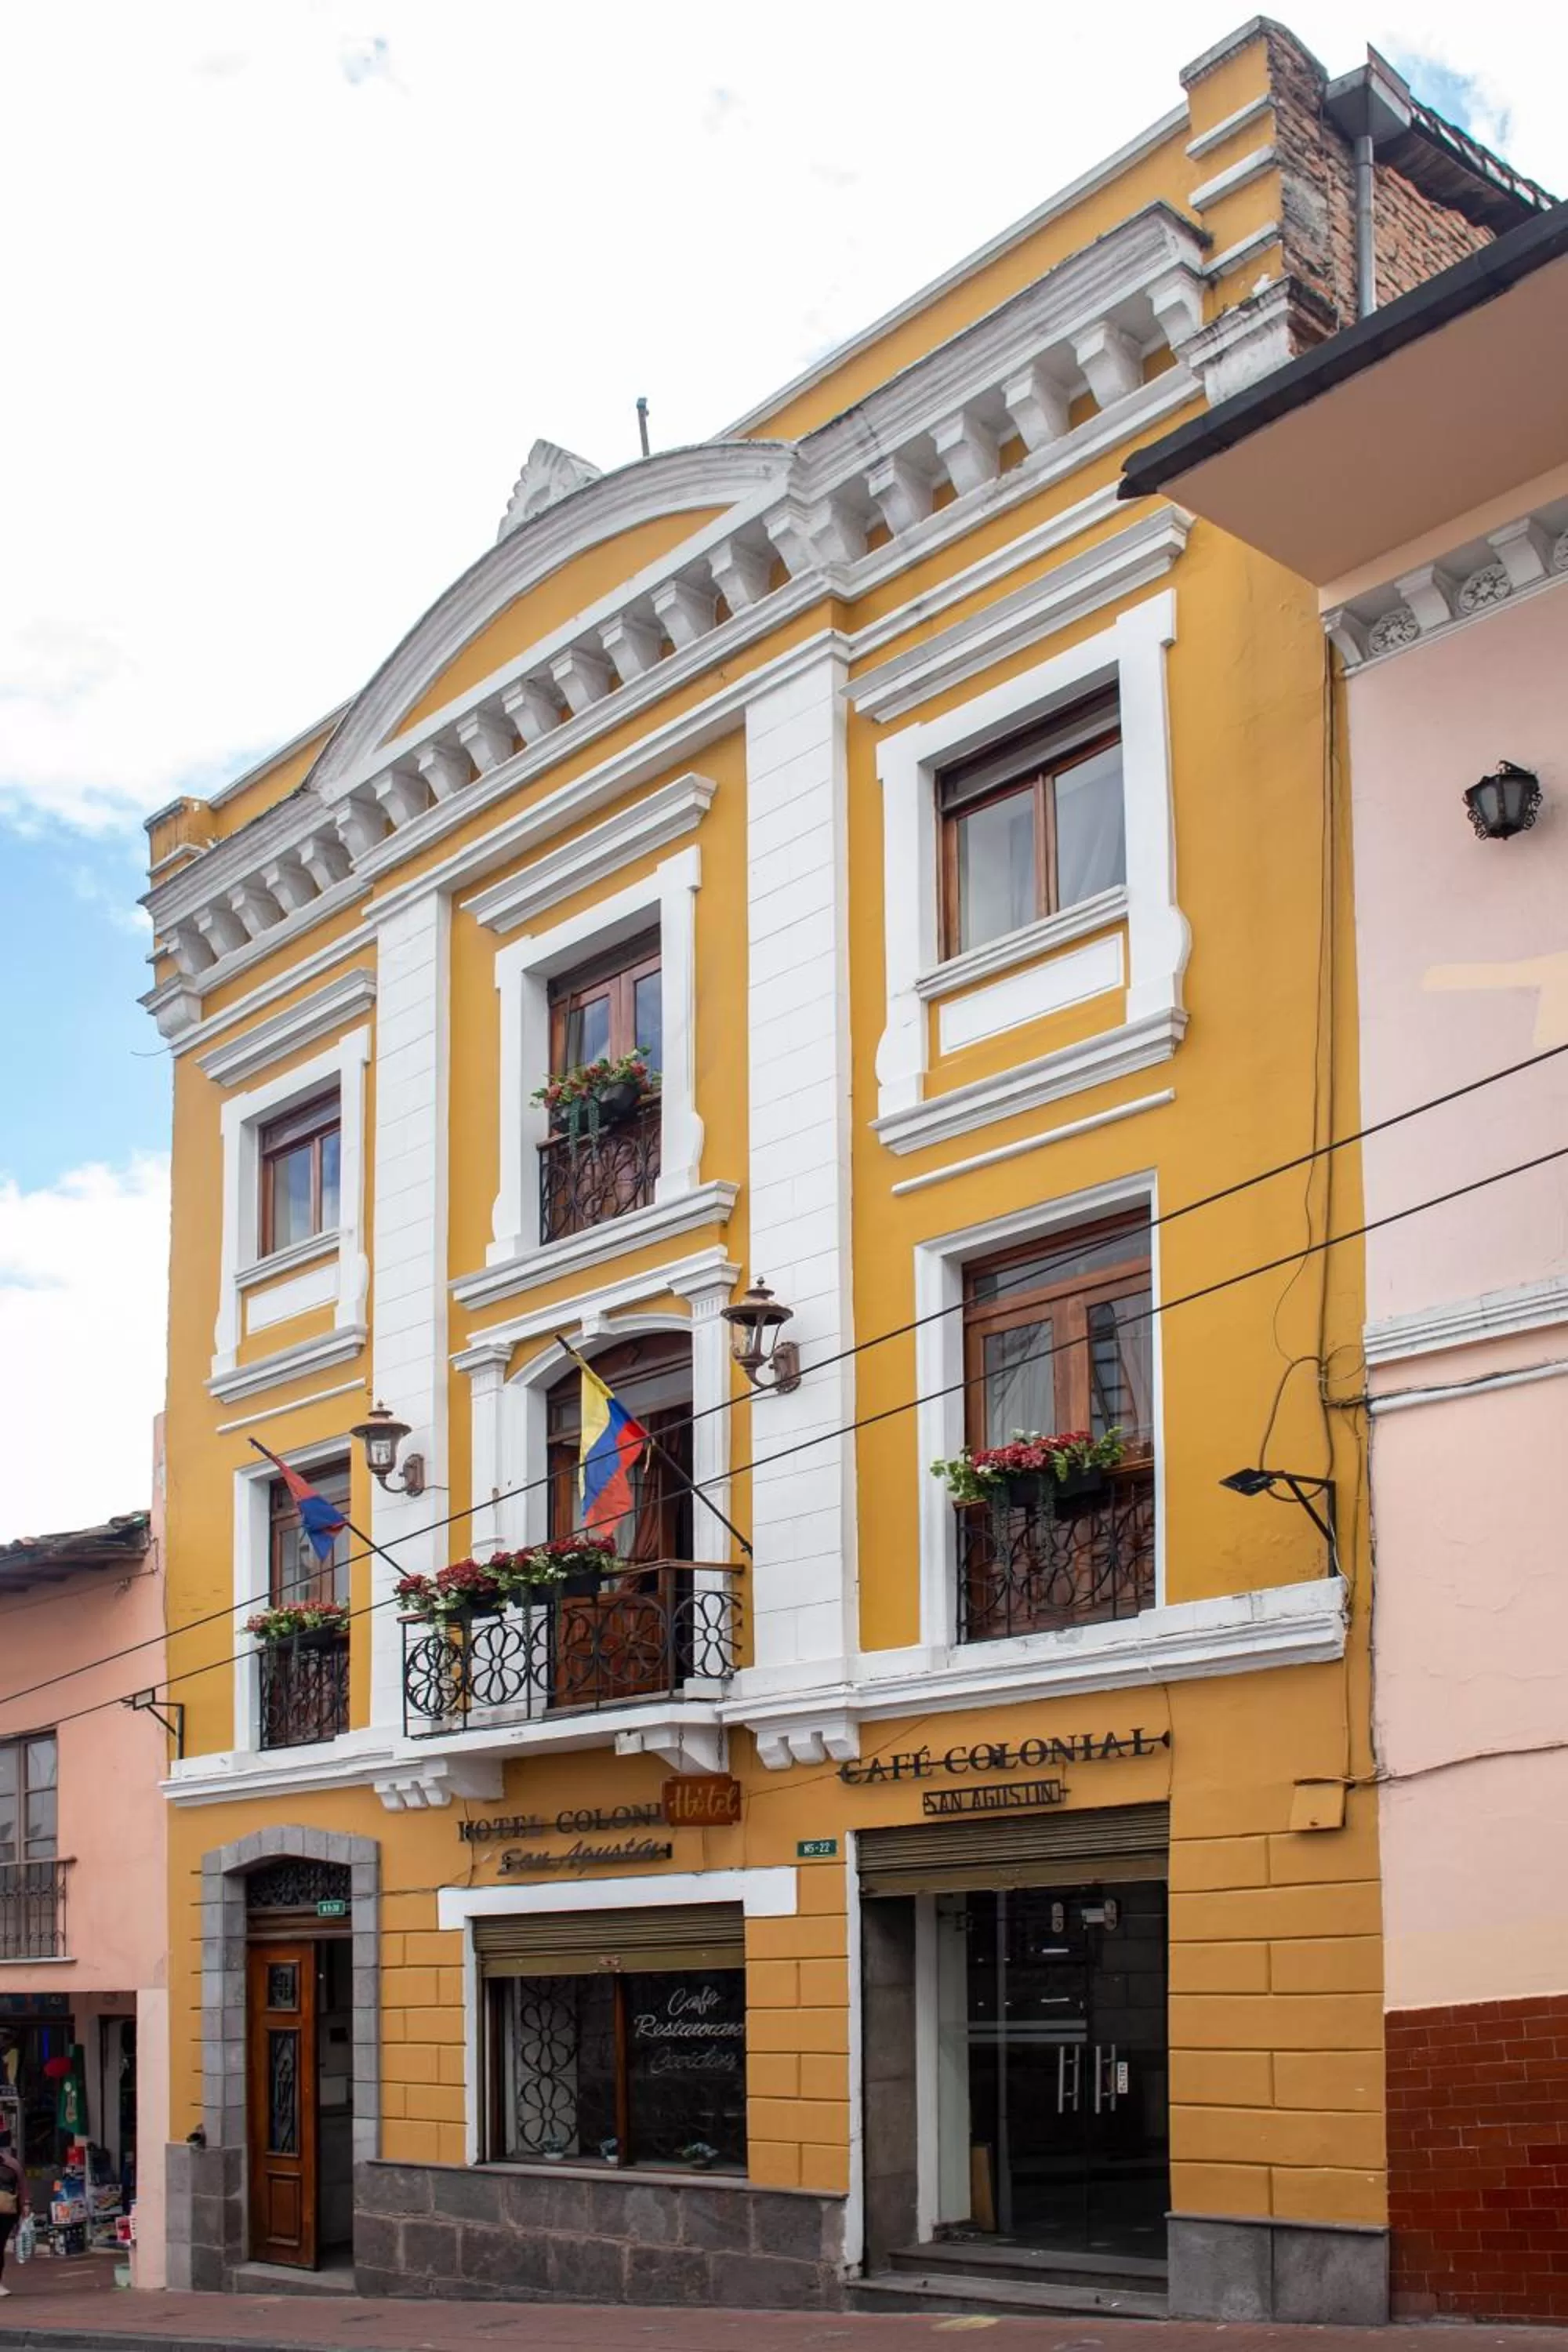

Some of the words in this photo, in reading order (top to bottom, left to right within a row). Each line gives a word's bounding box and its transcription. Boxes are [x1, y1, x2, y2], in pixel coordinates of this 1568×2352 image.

[840, 1745, 933, 1784] CAFÉ
[944, 1728, 1155, 1773] COLONIAL
[924, 1791, 963, 1815] SAN
[972, 1782, 1055, 1810] AGUSTIN
